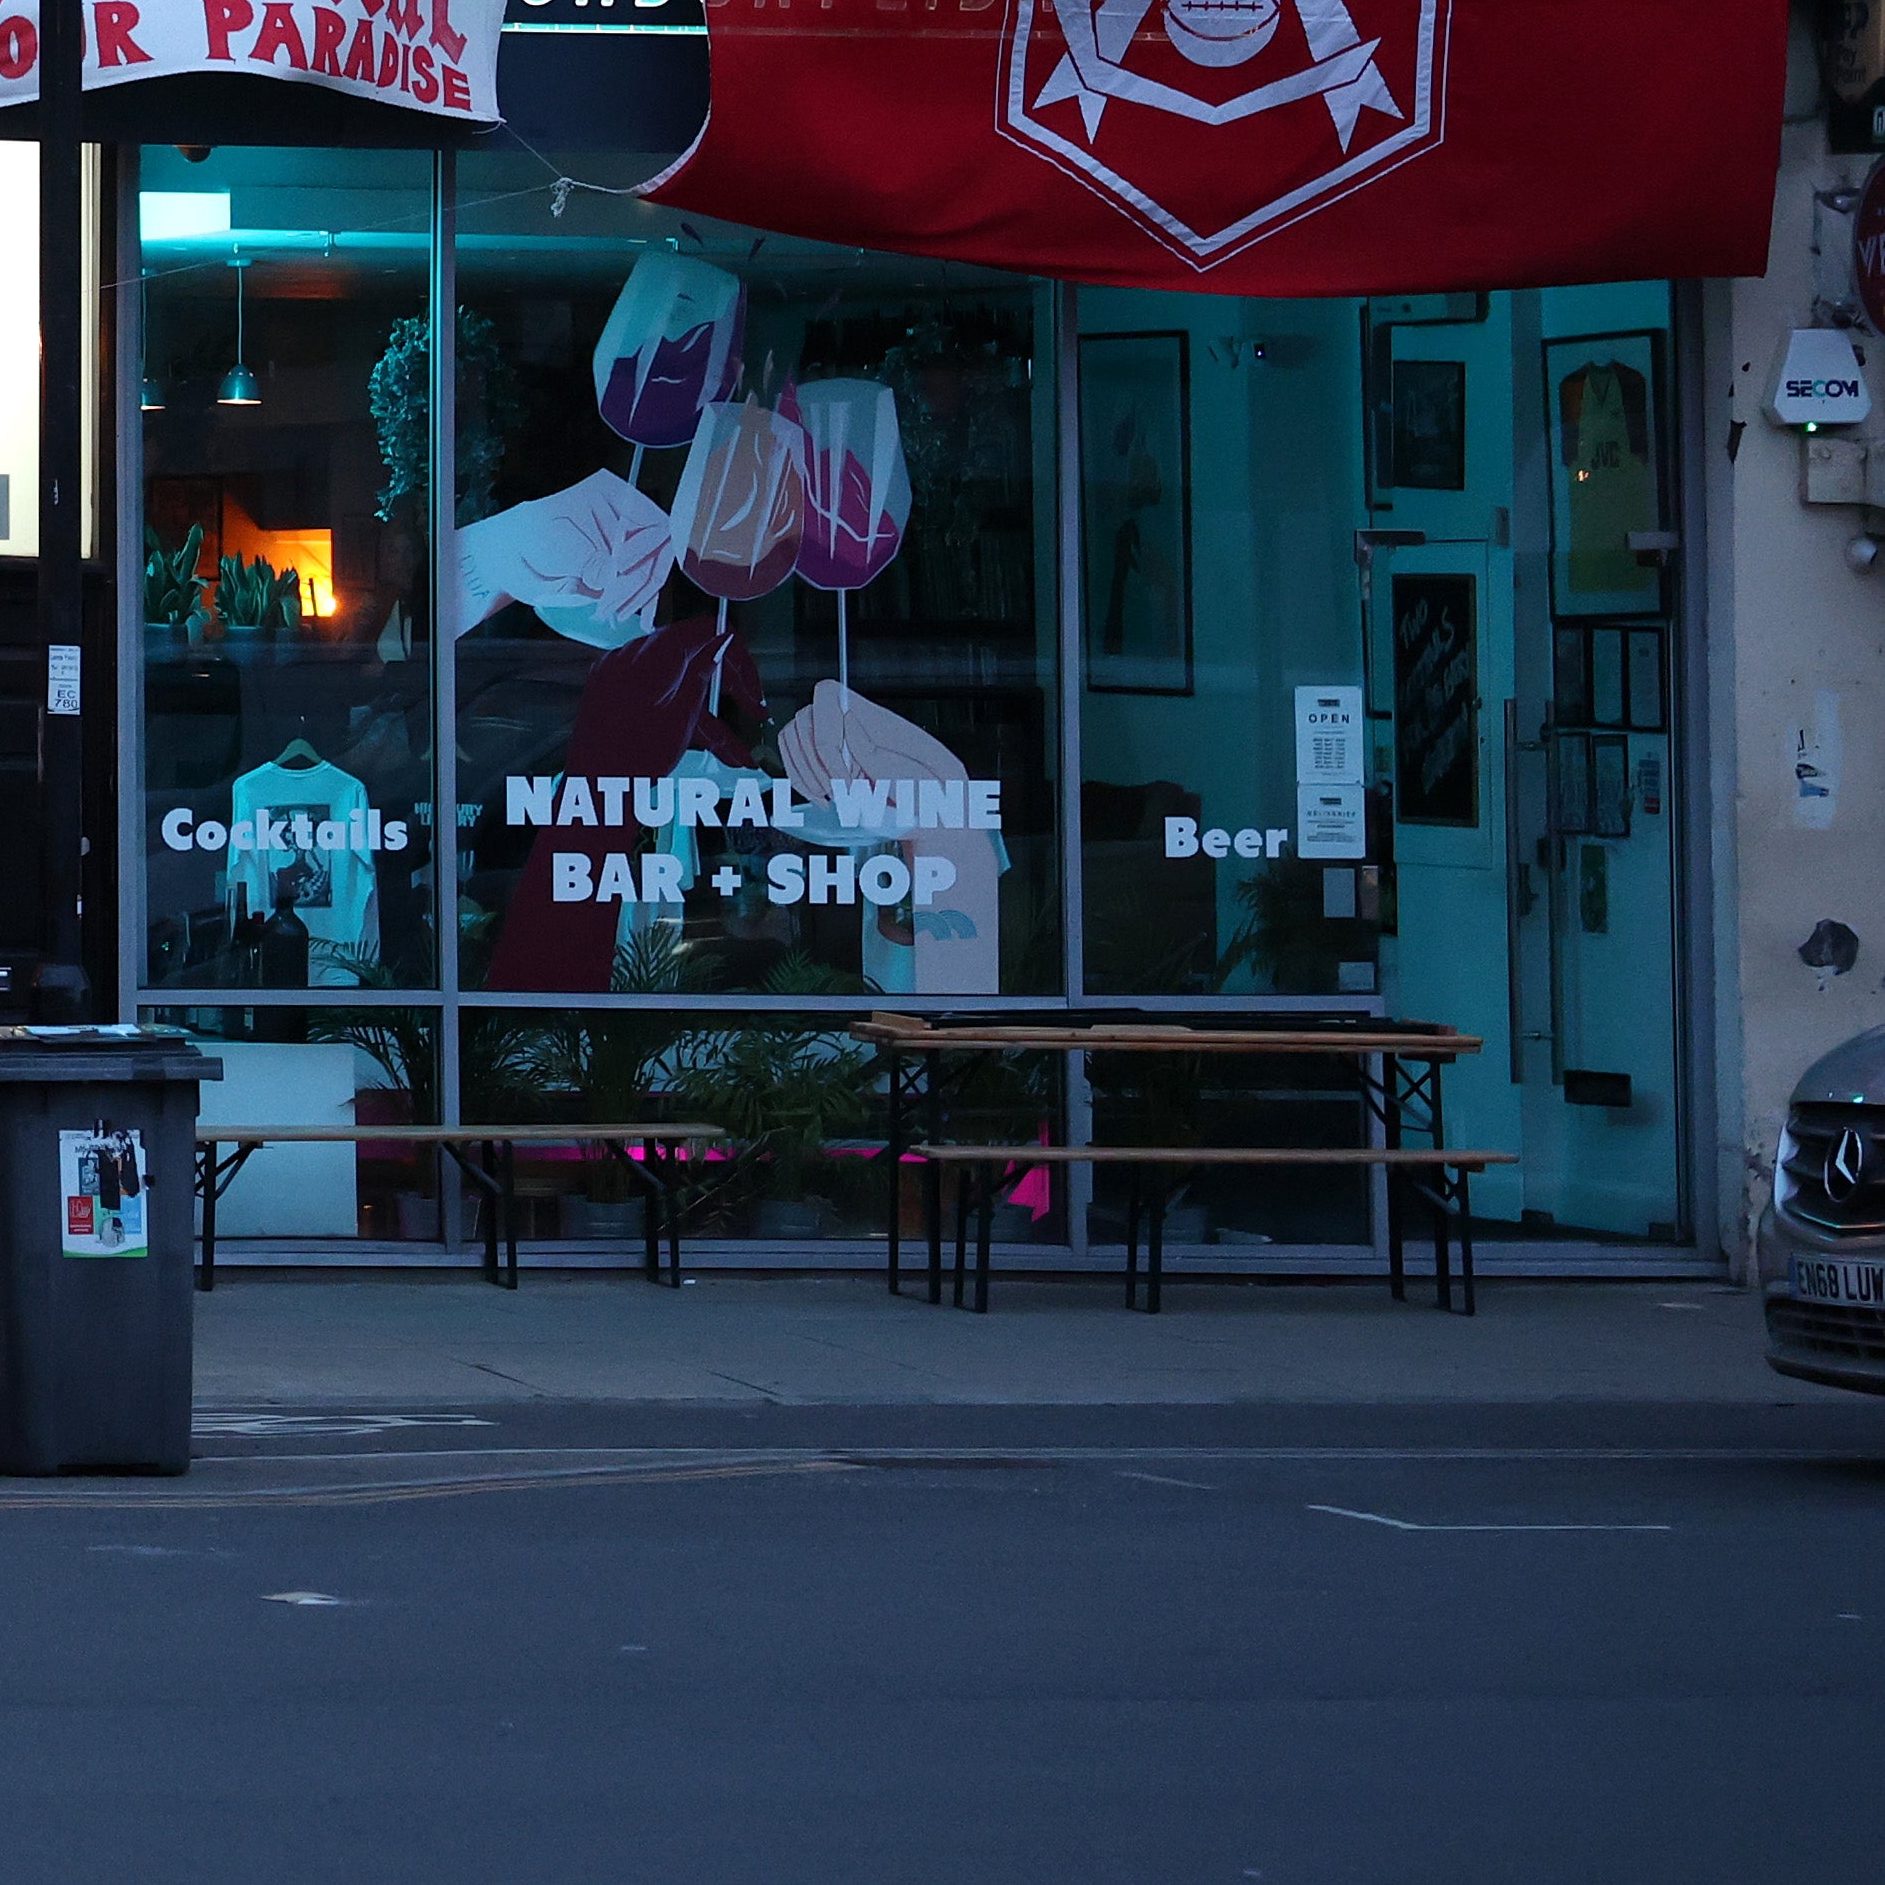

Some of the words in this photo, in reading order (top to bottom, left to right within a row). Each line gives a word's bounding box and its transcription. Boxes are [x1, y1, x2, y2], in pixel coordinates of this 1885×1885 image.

[1786, 379, 1859, 397] SECOM
[1308, 713, 1350, 724] OPEN
[505, 775, 805, 829] NATURAL
[830, 777, 1003, 831] WINE
[160, 805, 409, 853] Cocktails
[1164, 816, 1288, 859] Beer
[552, 851, 686, 904] BAR
[711, 863, 742, 898] +
[766, 852, 958, 905] SHOP
